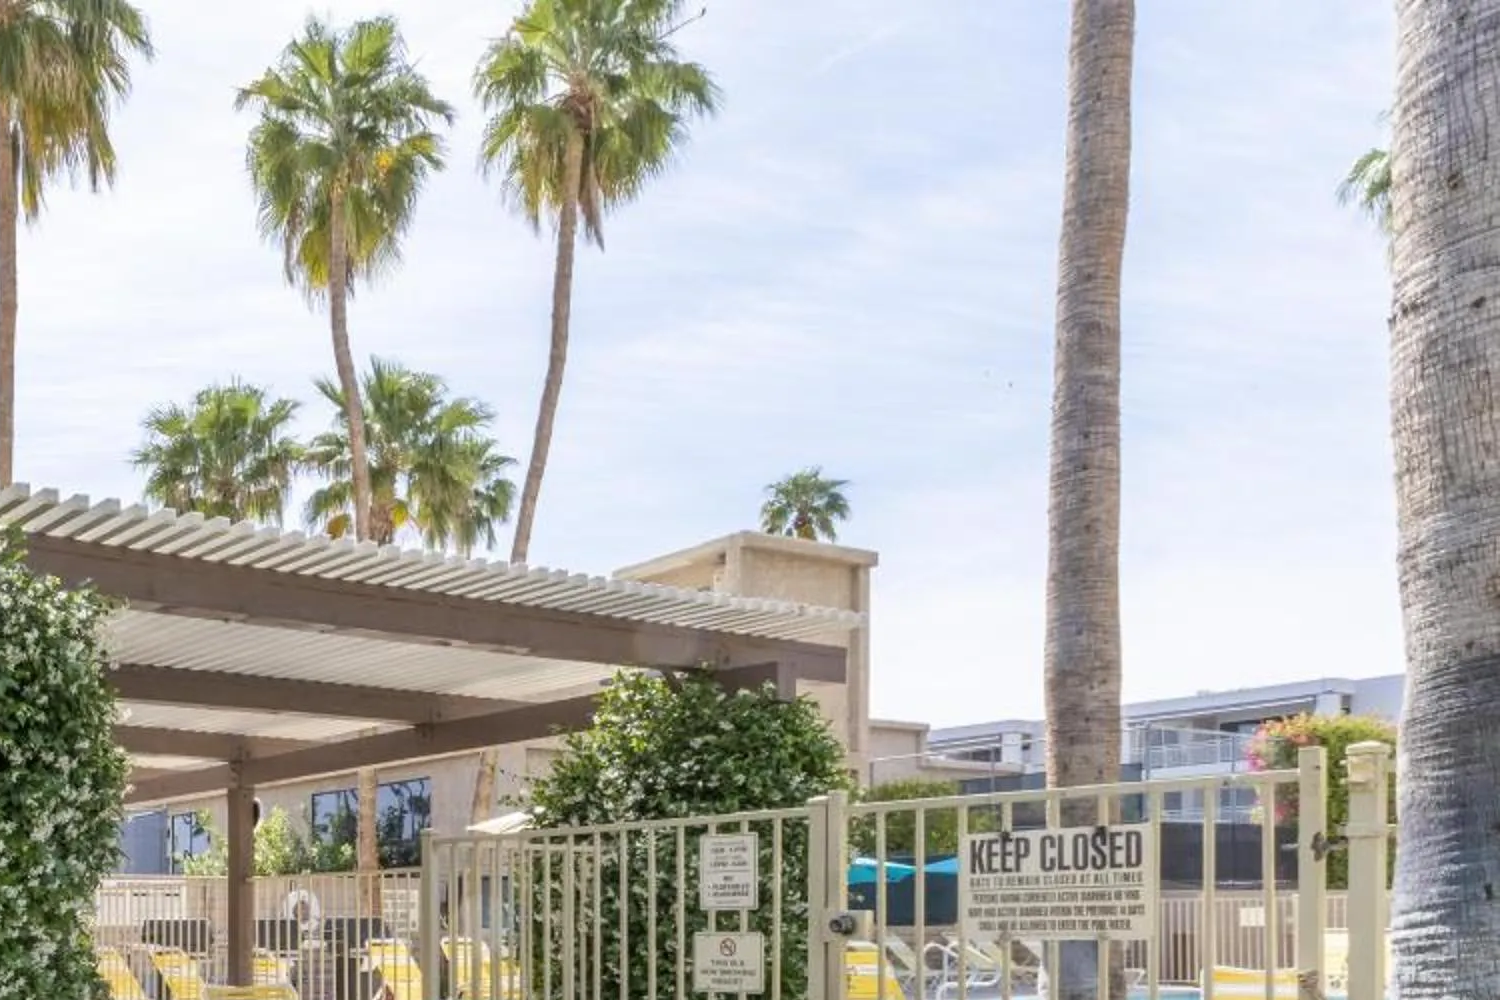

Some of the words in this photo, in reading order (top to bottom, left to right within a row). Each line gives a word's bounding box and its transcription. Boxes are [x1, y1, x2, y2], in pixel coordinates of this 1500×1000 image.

[970, 837, 1030, 874] KEEP
[1040, 830, 1143, 872] CLOSED
[1006, 875, 1040, 886] REMAIN
[1043, 873, 1077, 885] CLOSED
[1079, 873, 1092, 884] AT
[1094, 872, 1110, 884] ALL
[1113, 871, 1143, 883] TIMES
